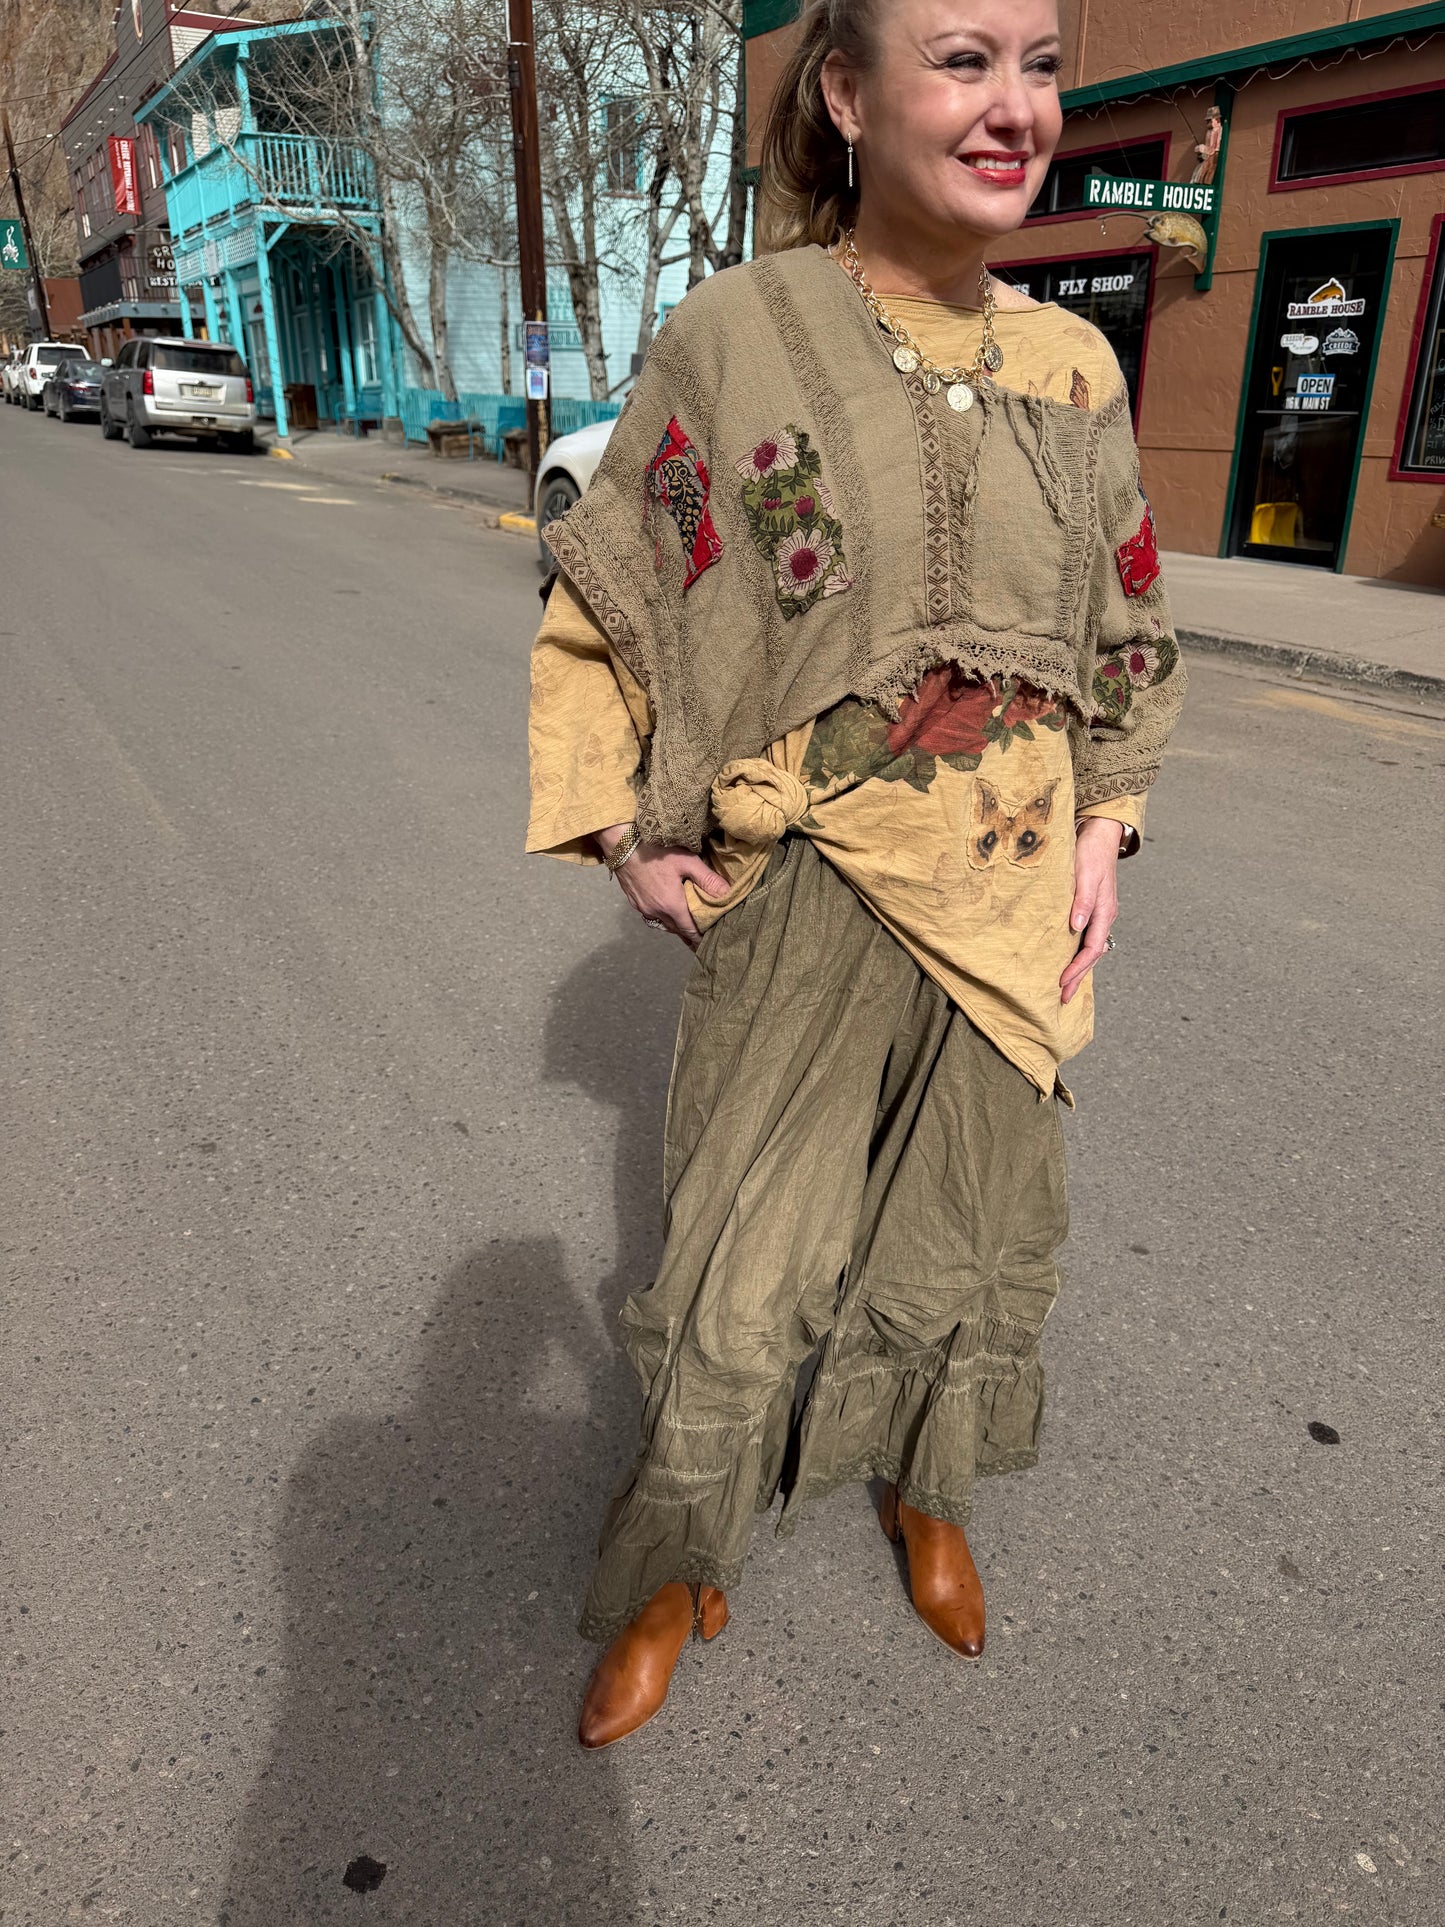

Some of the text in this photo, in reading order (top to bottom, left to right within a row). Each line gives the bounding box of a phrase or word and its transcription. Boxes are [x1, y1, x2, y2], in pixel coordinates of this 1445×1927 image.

[1089, 179, 1214, 210] RAMBLE HOUSE
[1058, 275, 1134, 296] FLY SHOP
[1289, 300, 1364, 316] RAMBLE HOUSE
[1301, 379, 1331, 393] OPEN
